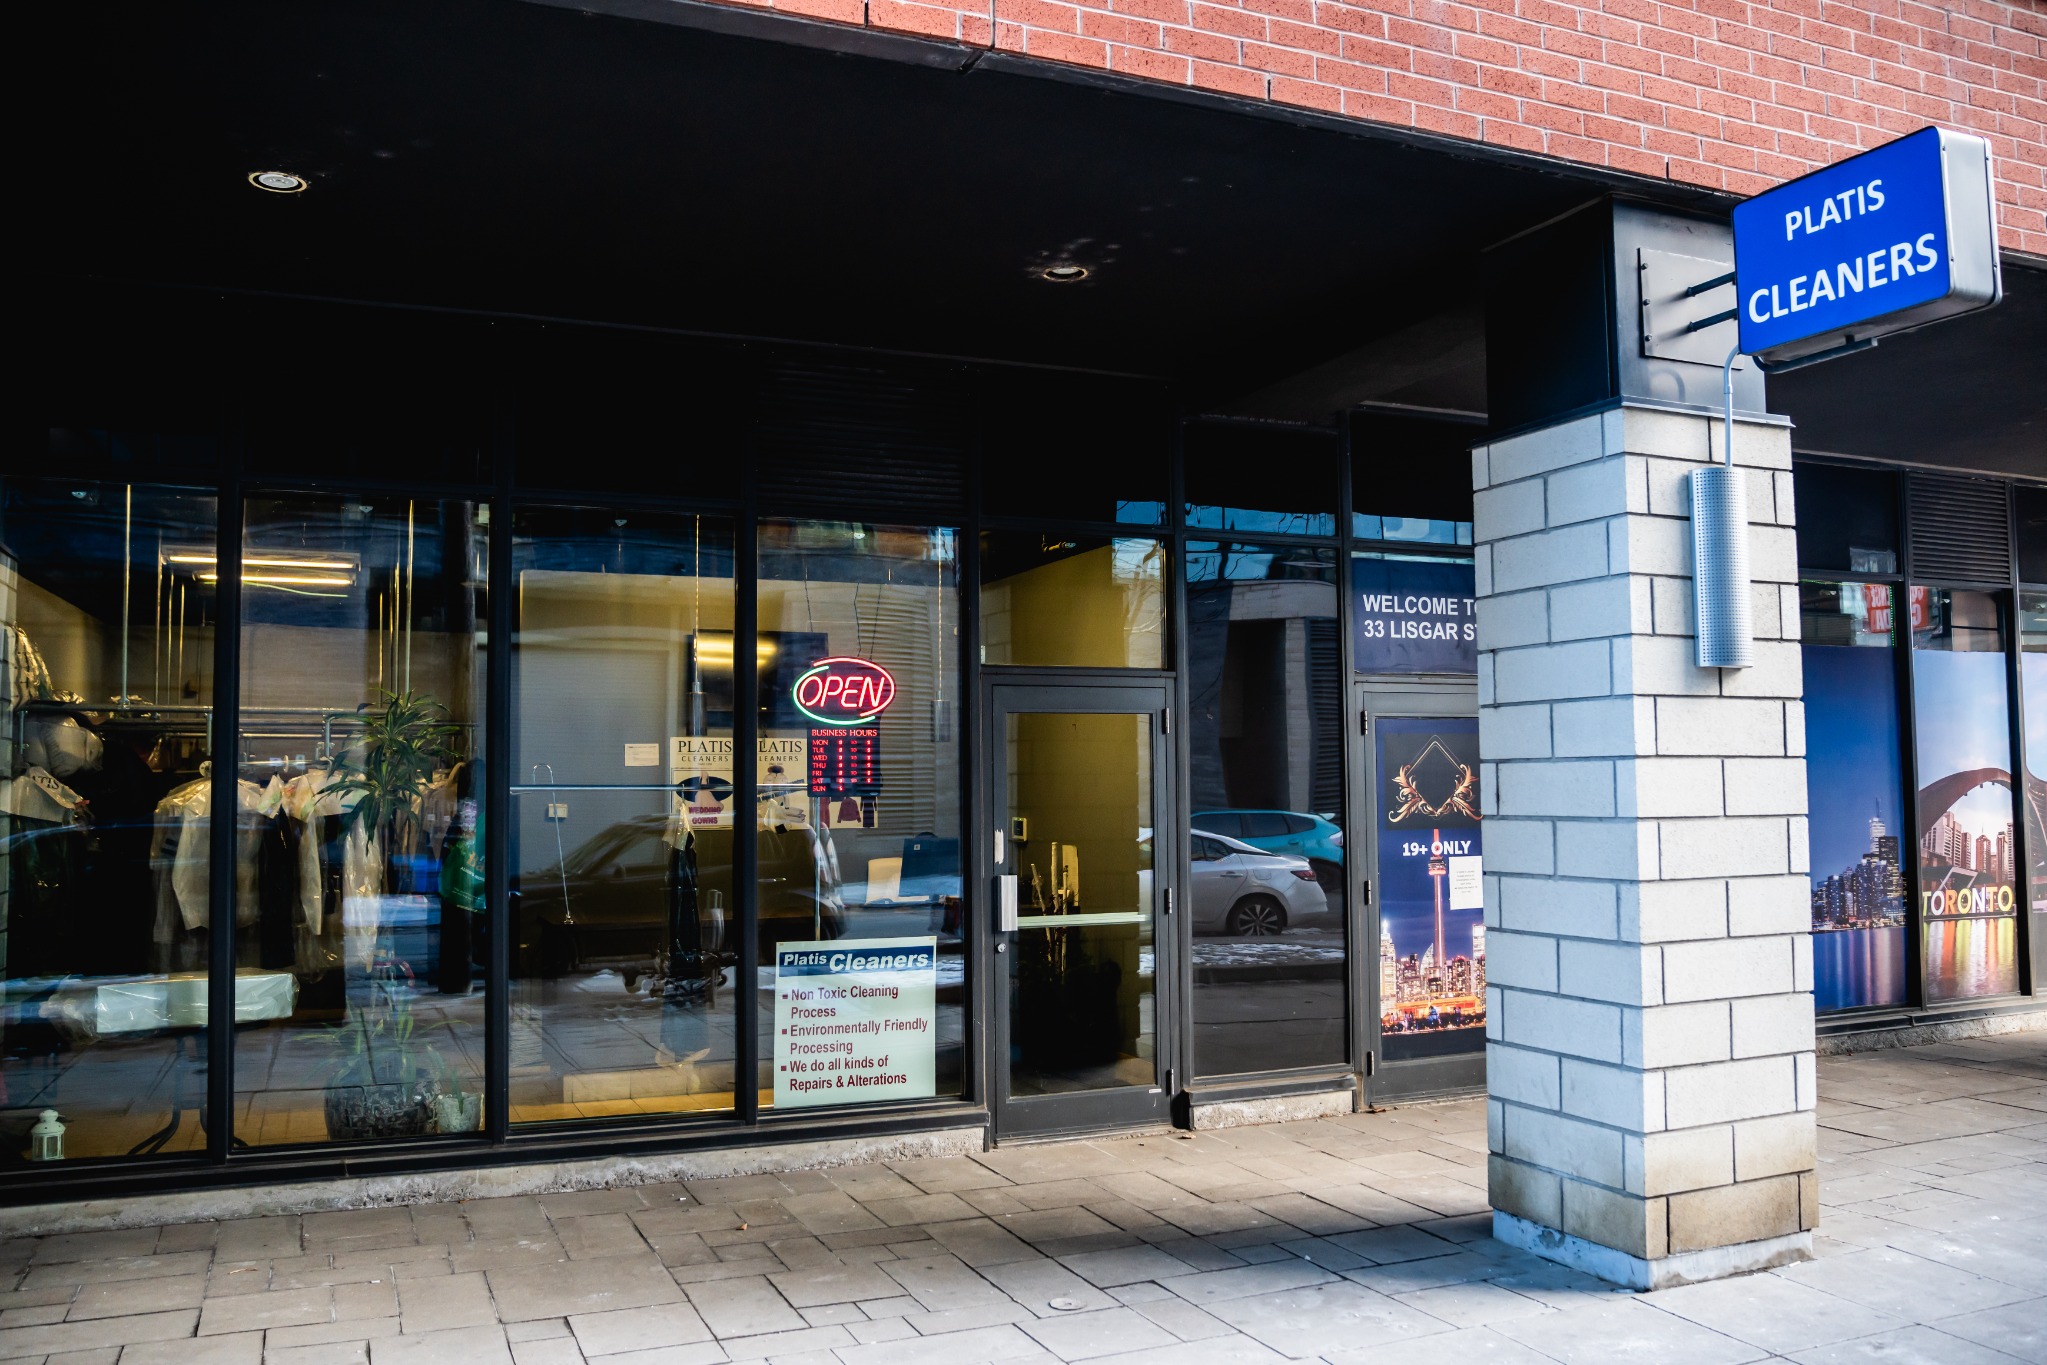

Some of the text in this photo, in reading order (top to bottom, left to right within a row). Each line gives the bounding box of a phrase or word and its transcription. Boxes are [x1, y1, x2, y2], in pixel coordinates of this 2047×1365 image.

[1785, 179, 1885, 241] PLATIS
[1748, 233, 1939, 324] CLEANERS
[1362, 594, 1477, 616] WELCOME T
[1364, 620, 1477, 641] 33 LISGAR S
[799, 675, 886, 708] OPEN
[812, 729, 878, 737] BUSINESS HOURS
[678, 740, 732, 753] PLATIS
[758, 740, 803, 753] LATIS
[689, 806, 721, 814] WEDDING
[692, 817, 718, 825] GOWNS
[1402, 841, 1471, 856] 19+ ONLY
[1922, 885, 2014, 916] TORONTO
[783, 953, 929, 972] Platis Cleaners
[791, 985, 899, 1001] Non Toxic Cleaning
[791, 1006, 836, 1019] Process
[790, 1018, 928, 1037] Environmentally Friendly
[790, 1040, 853, 1055] Processing
[789, 1055, 889, 1073] We do all kinds of
[789, 1073, 907, 1093] Repairs & Alterations
